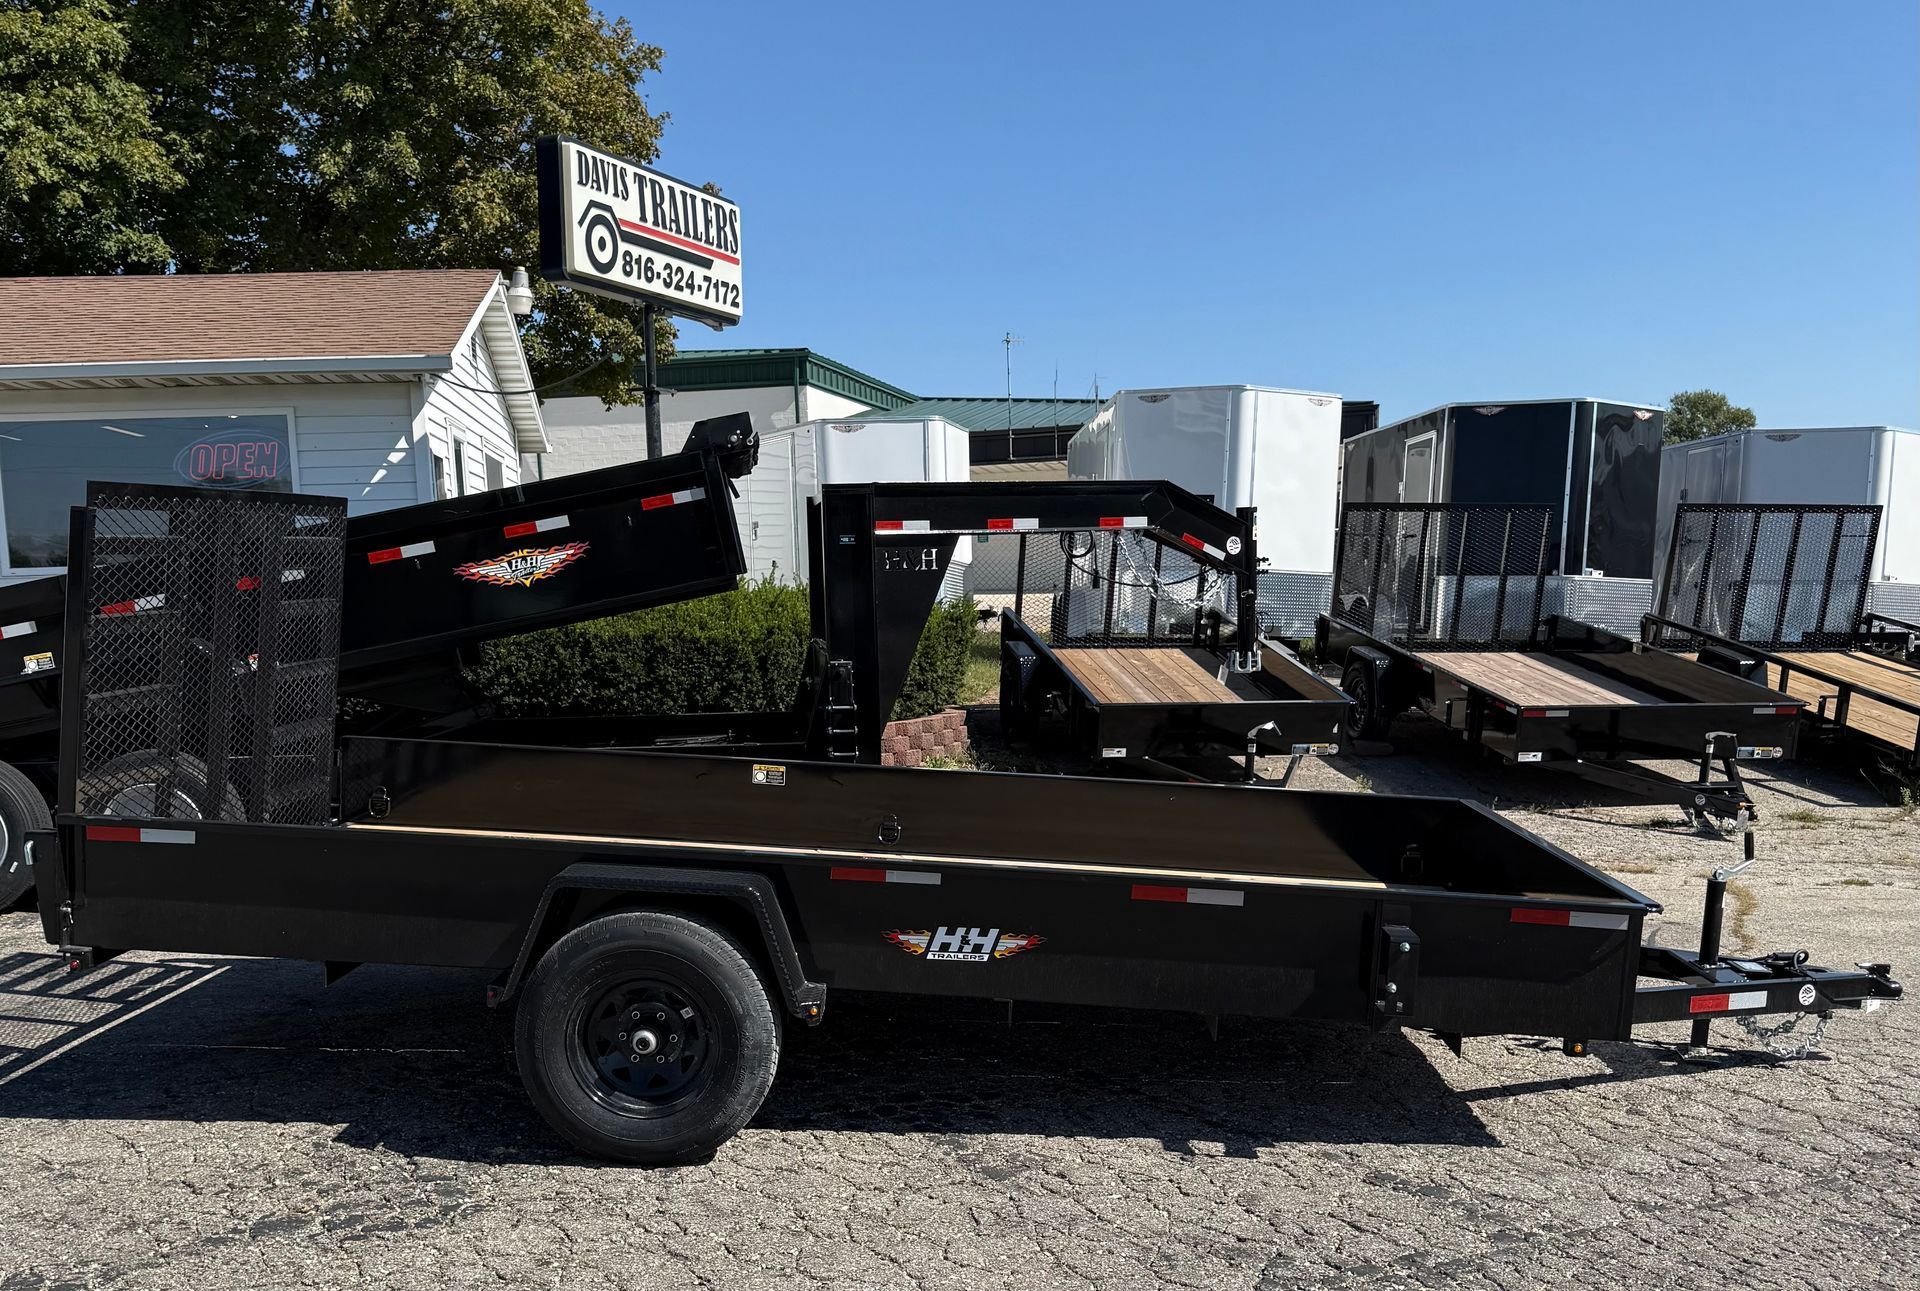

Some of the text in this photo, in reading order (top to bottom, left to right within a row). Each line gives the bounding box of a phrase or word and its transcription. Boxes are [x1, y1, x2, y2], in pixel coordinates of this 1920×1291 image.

[576, 150, 739, 255] DAVIS TRAILERS
[622, 250, 740, 308] 816-324-7172
[190, 441, 278, 480] OPEN
[511, 556, 538, 570] H&H
[930, 926, 1000, 953] H&H
